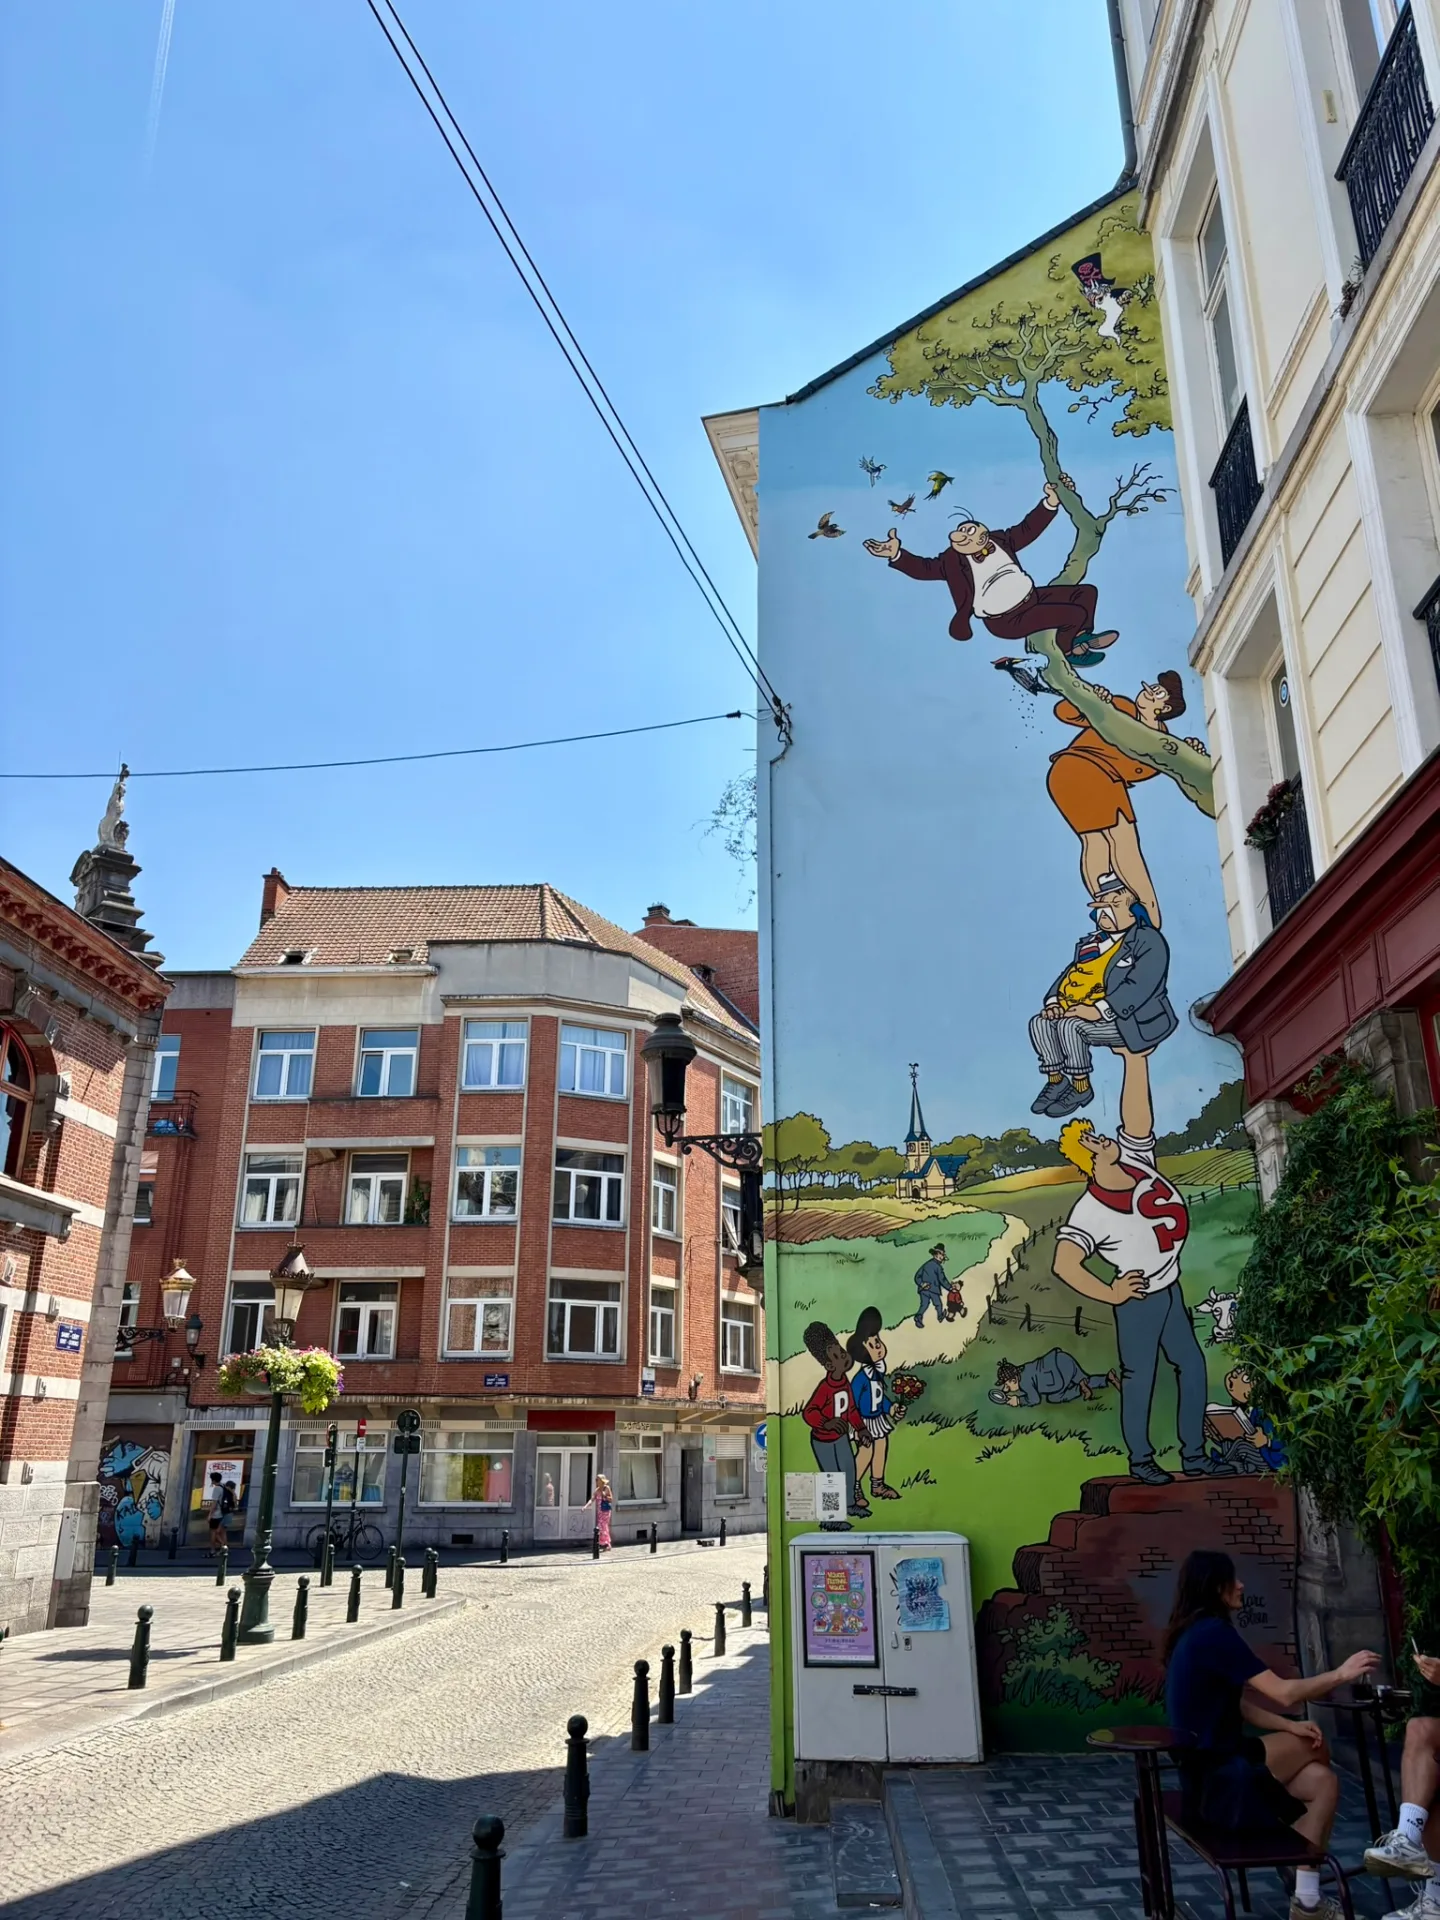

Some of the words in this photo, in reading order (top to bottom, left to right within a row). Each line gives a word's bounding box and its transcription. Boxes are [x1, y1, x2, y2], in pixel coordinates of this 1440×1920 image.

[1137, 1177, 1189, 1253] S
[834, 1391, 849, 1418] P
[870, 1380, 883, 1412] P
